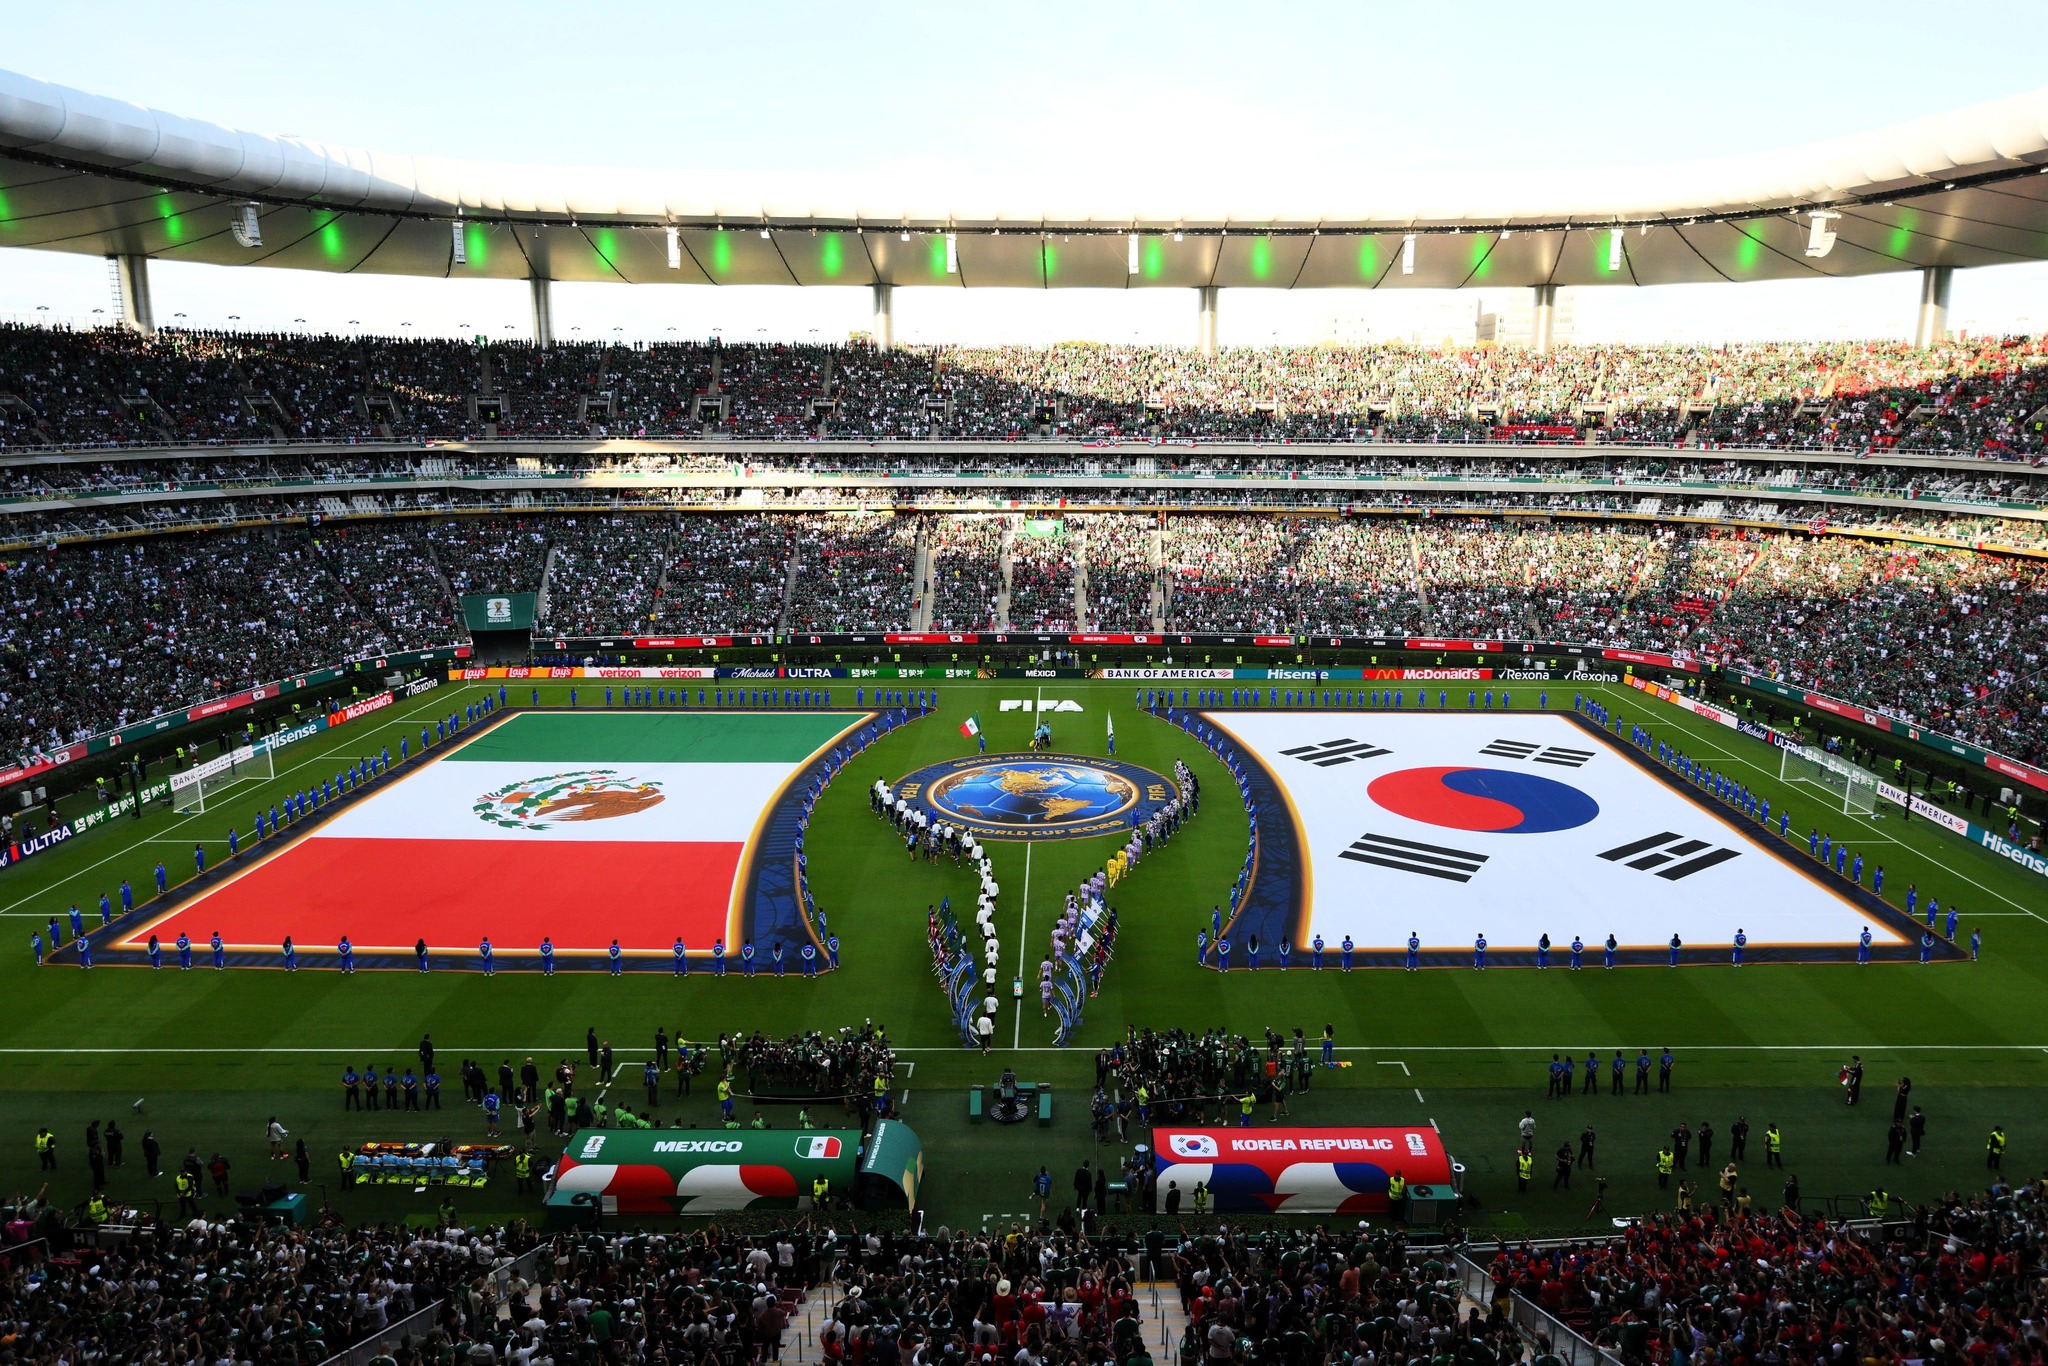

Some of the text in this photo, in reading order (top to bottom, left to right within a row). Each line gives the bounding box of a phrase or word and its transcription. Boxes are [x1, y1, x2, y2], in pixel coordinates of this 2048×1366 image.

[1941, 497, 1999, 507] GUADALAJARA
[464, 667, 486, 679] Lay's
[509, 667, 529, 678] Lay's
[552, 667, 571, 678] Lay's
[600, 669, 641, 678] verizon
[660, 669, 702, 678] verizon
[731, 668, 832, 678] Michelob ULTRA
[1026, 669, 1056, 677] MÉXICO
[1107, 670, 1216, 678] BANK OF AMERICA
[1267, 669, 1329, 679] Hisense
[1403, 669, 1480, 679] McDonald's
[1507, 670, 1549, 680] Rexona
[1573, 670, 1618, 682] Rexona
[411, 679, 438, 696] Rexona
[346, 695, 393, 720] McDonald's
[1000, 700, 1083, 711] FIFA
[1693, 703, 1721, 722] verizon
[265, 724, 317, 751] Hisense
[1738, 720, 1803, 756] Michelob ULTRA
[1036, 755, 1087, 763] WORLD
[173, 773, 196, 787] BANK
[900, 783, 922, 799] FIFA
[1147, 783, 1166, 801] FIFA
[1880, 785, 1901, 801] BANK
[1915, 802, 1953, 826] AMERICA
[969, 826, 1029, 836] WORLD
[1069, 819, 1125, 833] 2026
[22, 825, 72, 856] ULTRA
[653, 1141, 743, 1152] MEXICO
[1231, 1138, 1393, 1150] KOREA REPUBLIC
[73, 1232, 86, 1244] H
[1893, 1226, 1905, 1238] G
